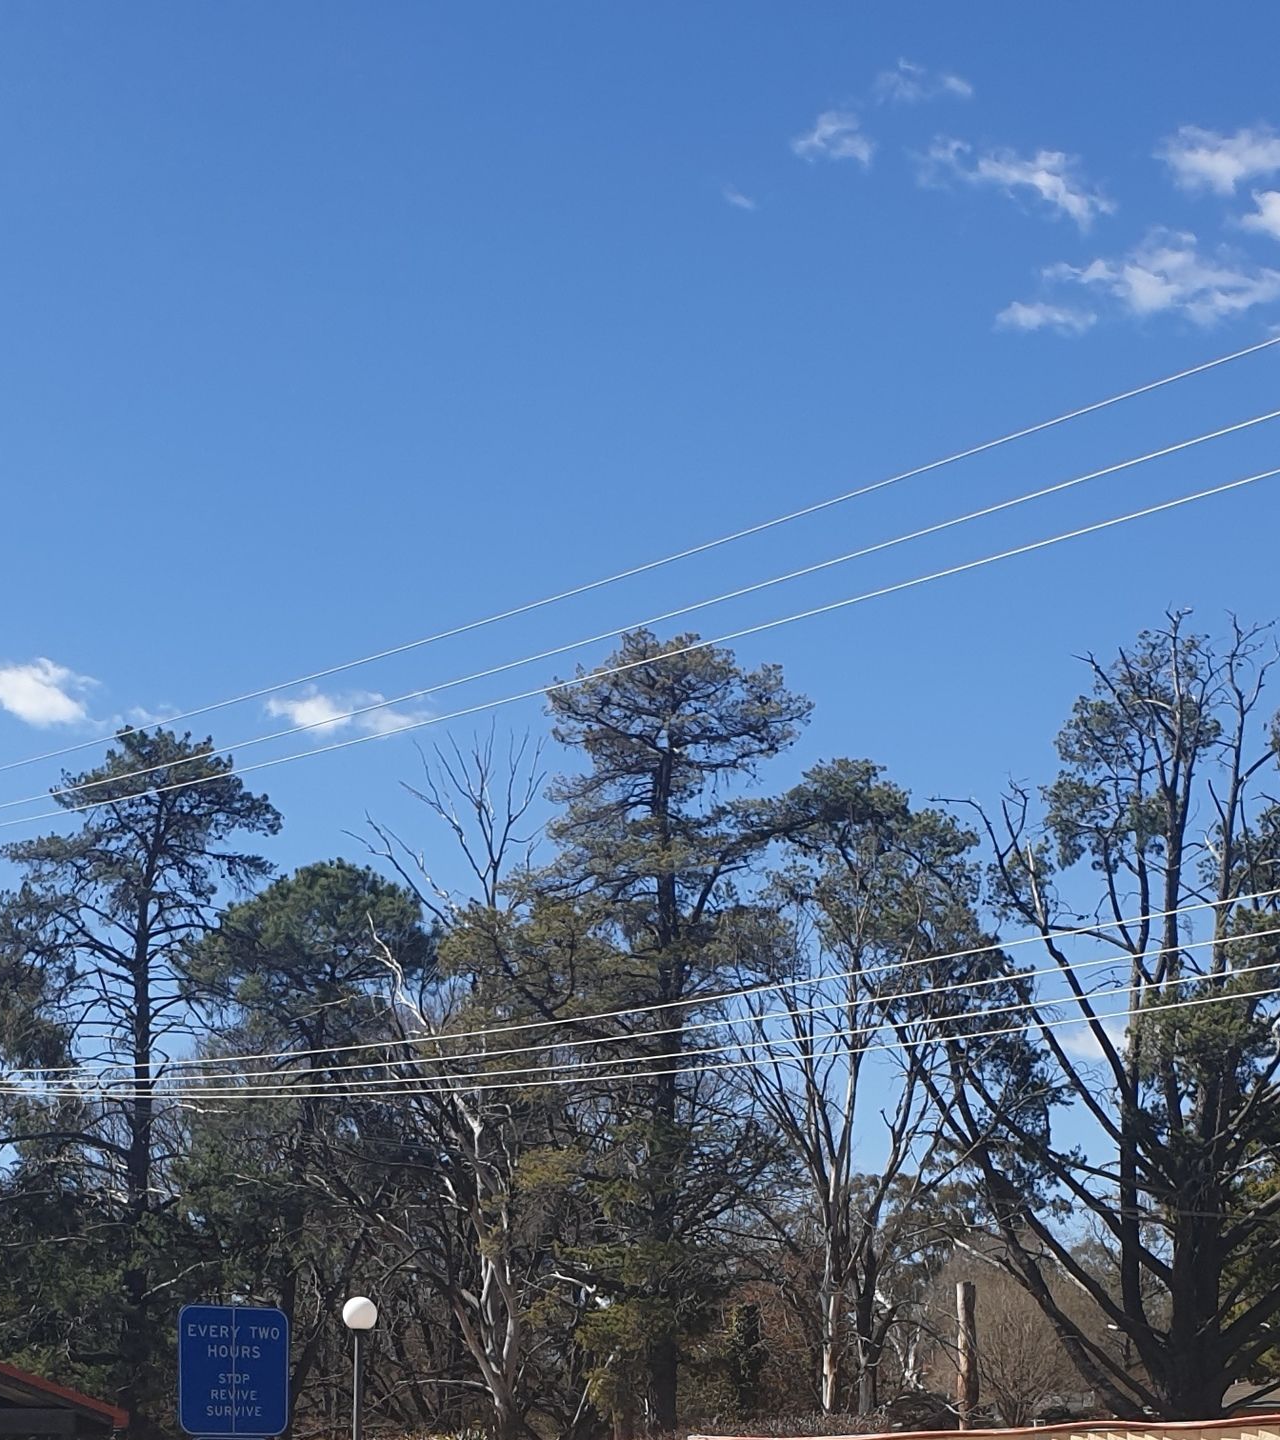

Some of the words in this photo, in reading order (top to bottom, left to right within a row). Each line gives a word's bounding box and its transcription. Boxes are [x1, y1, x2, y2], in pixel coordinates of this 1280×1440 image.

[187, 1323, 240, 1339] EVERY
[250, 1326, 280, 1340] TWO
[207, 1344, 261, 1359] HOURS
[218, 1373, 250, 1385] STOP
[210, 1389, 258, 1401] REVIVE
[206, 1405, 262, 1417] SURVIVE
